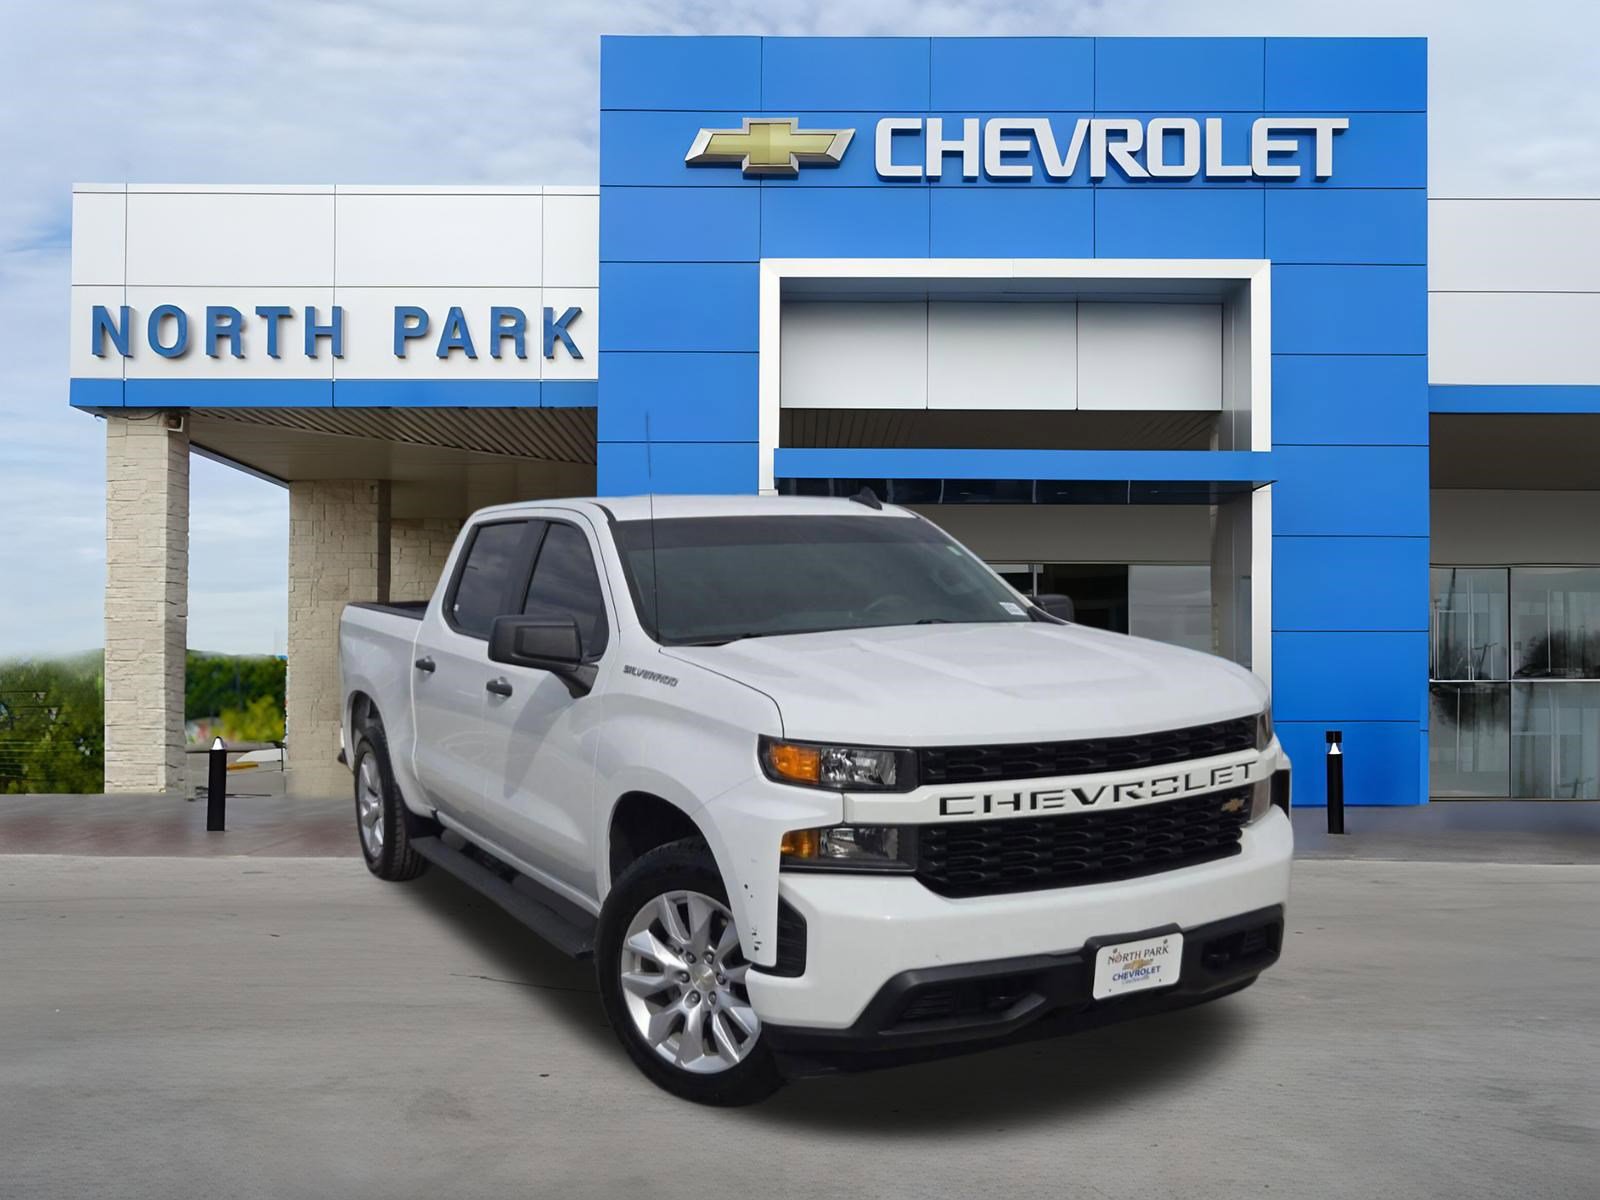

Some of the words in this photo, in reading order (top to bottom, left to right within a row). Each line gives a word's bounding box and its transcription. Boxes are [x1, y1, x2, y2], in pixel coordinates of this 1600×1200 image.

[875, 117, 1350, 180] CHEVROLET
[91, 303, 346, 360] NORTH
[393, 305, 586, 361] PARK
[623, 664, 679, 688] SILVERADO
[938, 760, 1257, 817] CHEVROLET
[1108, 950, 1141, 964] NORTH
[1143, 945, 1169, 958] PARK
[1112, 965, 1161, 982] CHEVROLET
